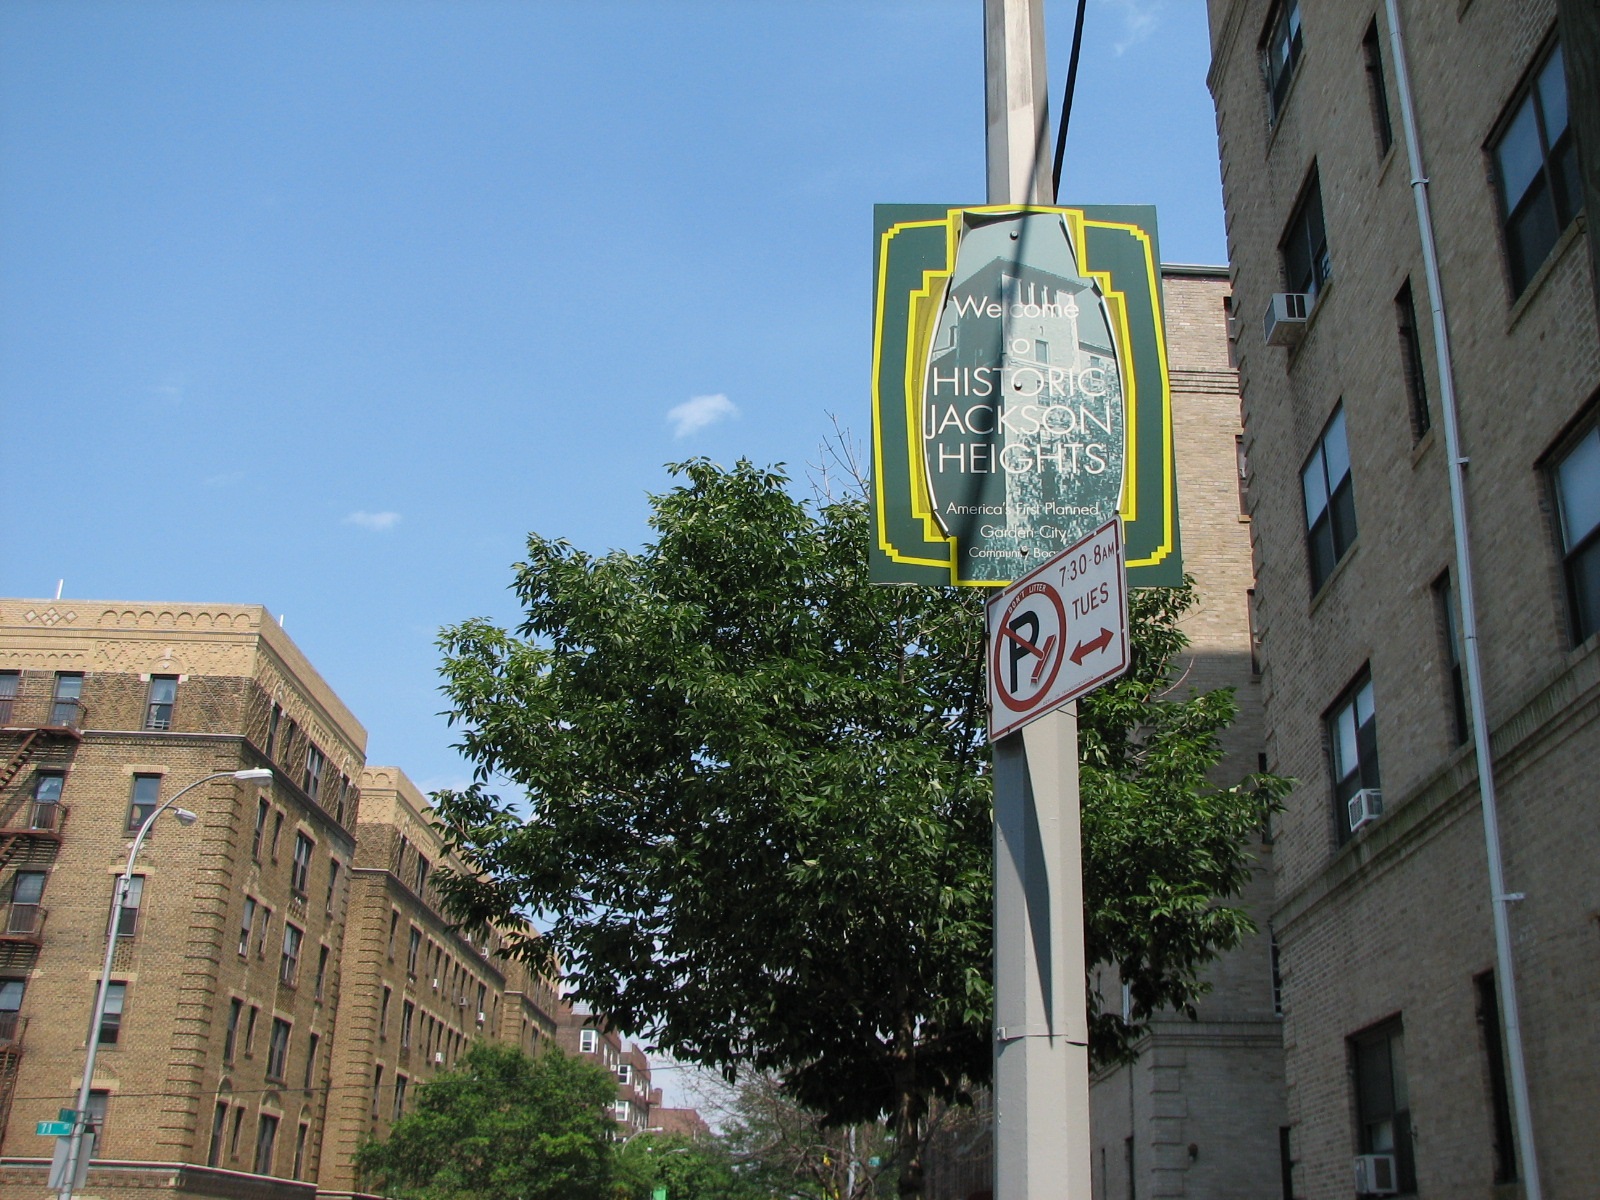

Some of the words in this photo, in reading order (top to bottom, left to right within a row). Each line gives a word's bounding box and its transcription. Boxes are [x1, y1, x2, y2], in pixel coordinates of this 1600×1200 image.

[953, 295, 1080, 319] Wecome
[933, 367, 1107, 397] HISTORIC
[925, 404, 1112, 440] JACKSON
[938, 443, 1107, 474] HEIGHTS
[946, 501, 1011, 516] America's
[1016, 502, 1040, 516] First
[1045, 501, 1100, 516] Planned
[980, 525, 1034, 539] Garden
[1039, 524, 1068, 542] City
[969, 546, 1030, 561] Communiy
[1008, 590, 1025, 614] DON'T
[1028, 583, 1047, 593] LITTER
[1072, 581, 1109, 620] TUES
